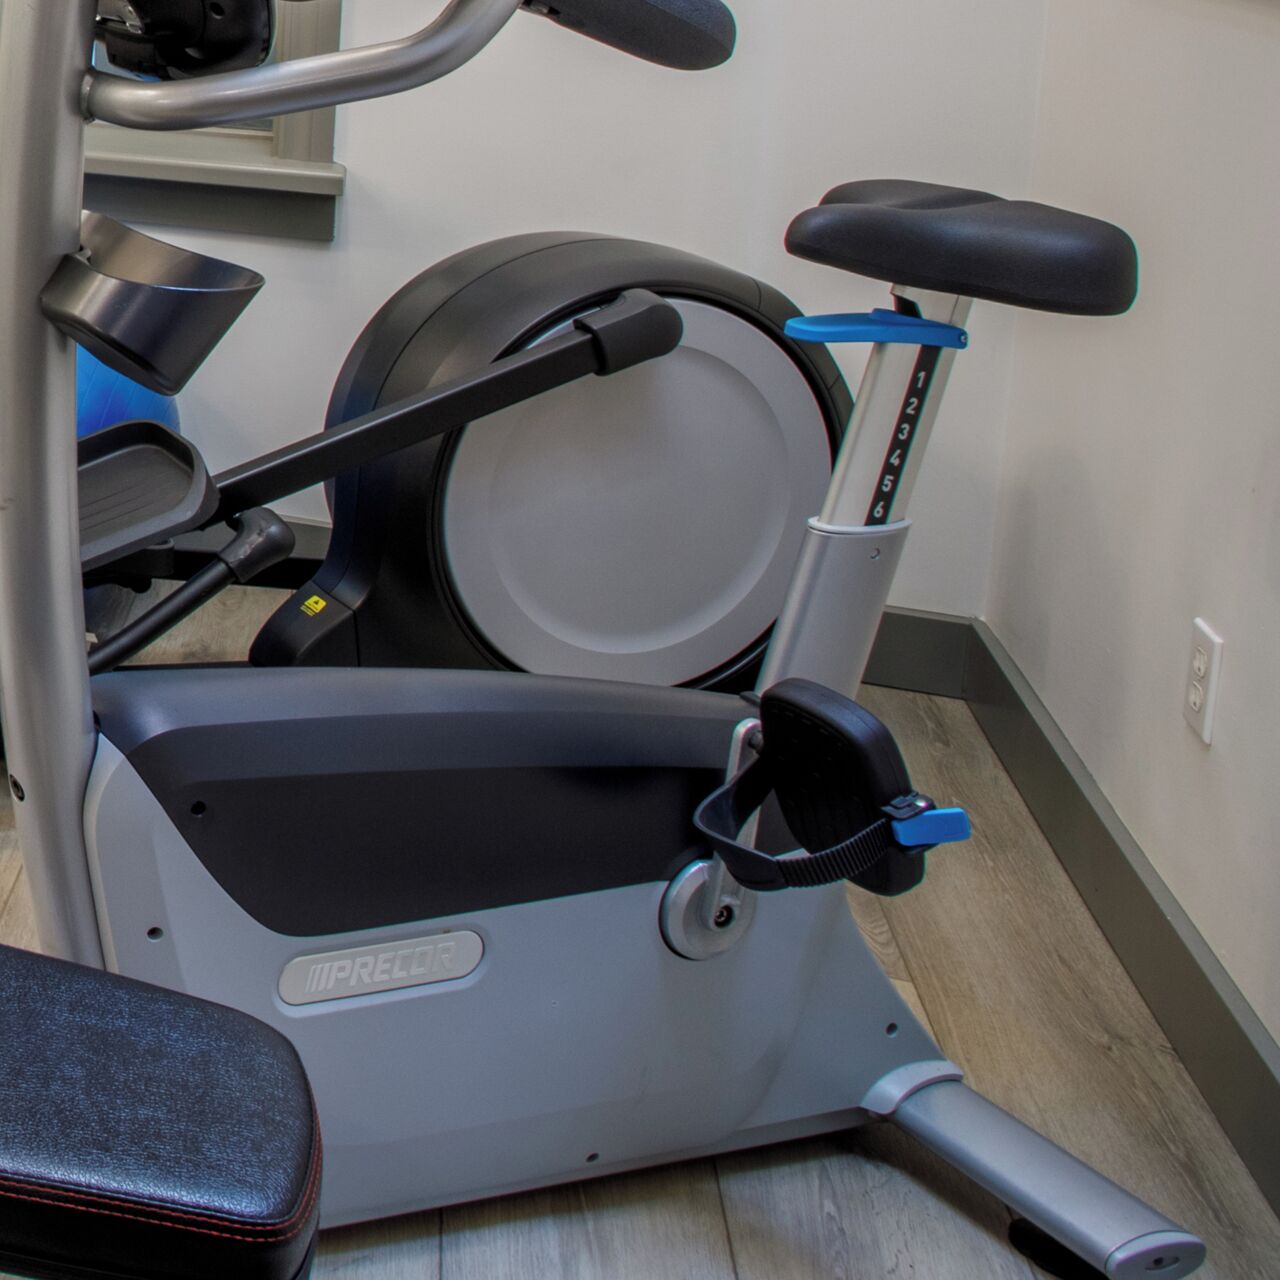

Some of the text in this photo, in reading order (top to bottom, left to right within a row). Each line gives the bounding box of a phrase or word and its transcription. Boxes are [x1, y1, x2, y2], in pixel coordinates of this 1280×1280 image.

[917, 371, 926, 388] 1
[905, 397, 919, 415] 2
[897, 423, 910, 440] 3
[889, 449, 901, 467] 4
[881, 475, 894, 492] 5
[873, 501, 884, 518] 6
[326, 941, 456, 991] PRECOR
